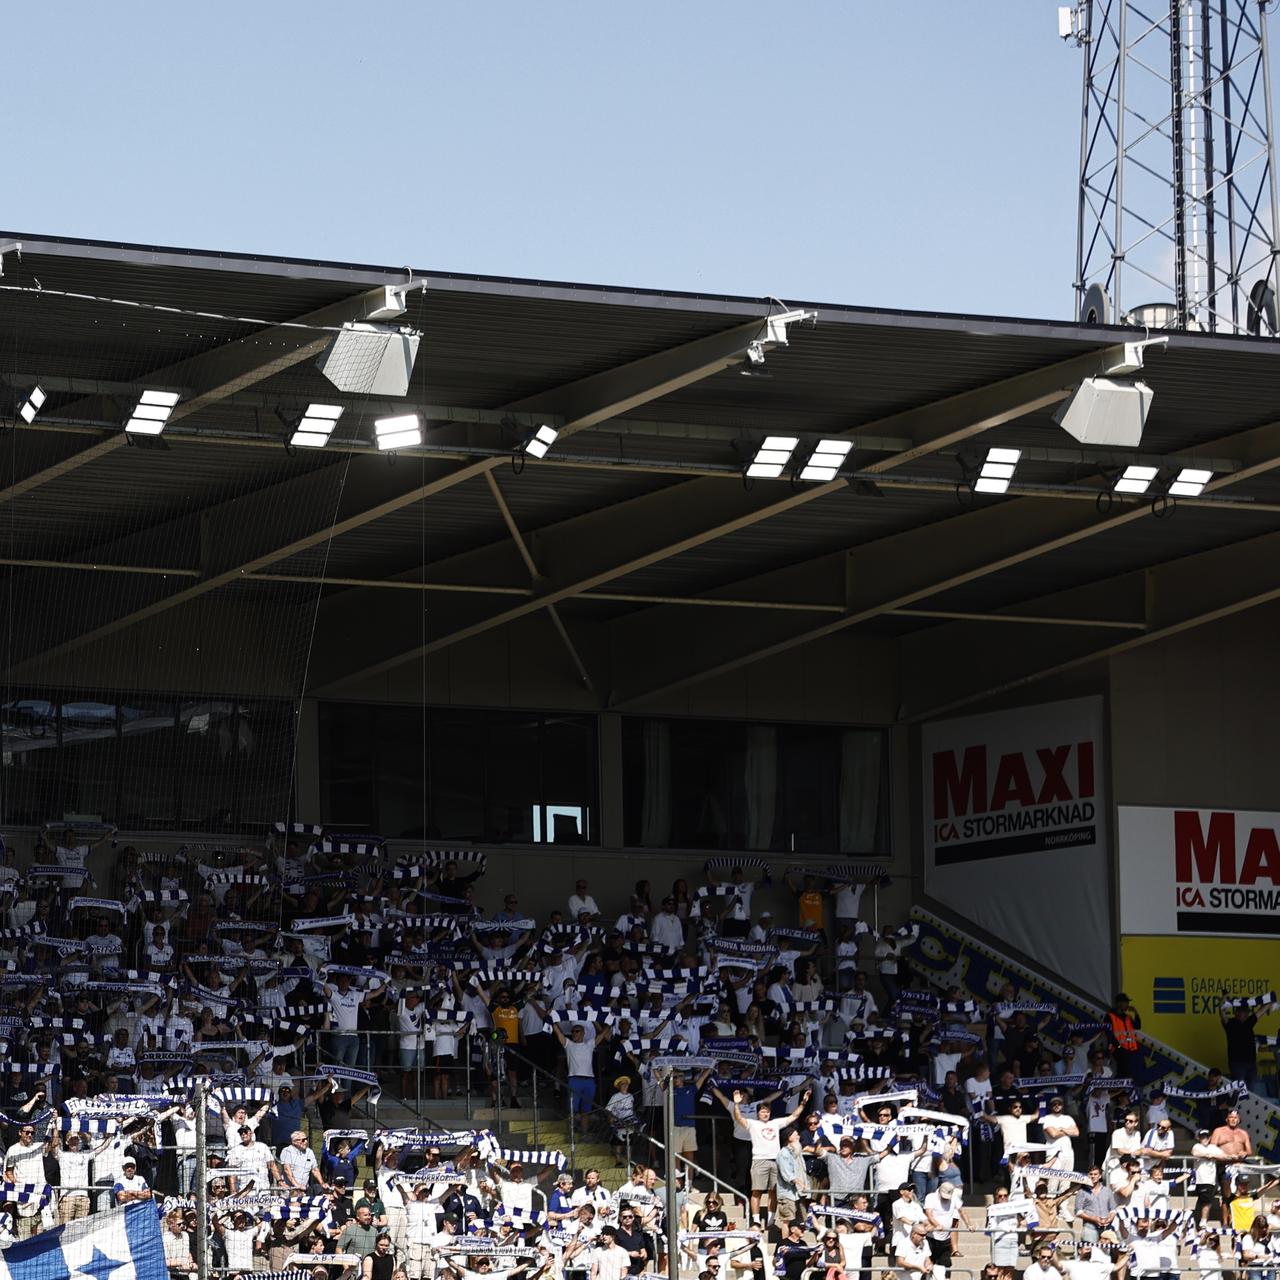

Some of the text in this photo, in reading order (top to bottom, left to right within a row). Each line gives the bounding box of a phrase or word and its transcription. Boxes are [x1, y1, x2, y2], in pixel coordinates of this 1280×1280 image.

[932, 740, 1096, 820] MAXI
[934, 802, 1096, 843] ICA STORMARKNAD
[1176, 886, 1205, 908] ICA
[739, 942, 777, 953] NORDAHL
[1191, 977, 1271, 996] GARAGEPORT
[232, 1196, 284, 1208] NORRKÖPING
